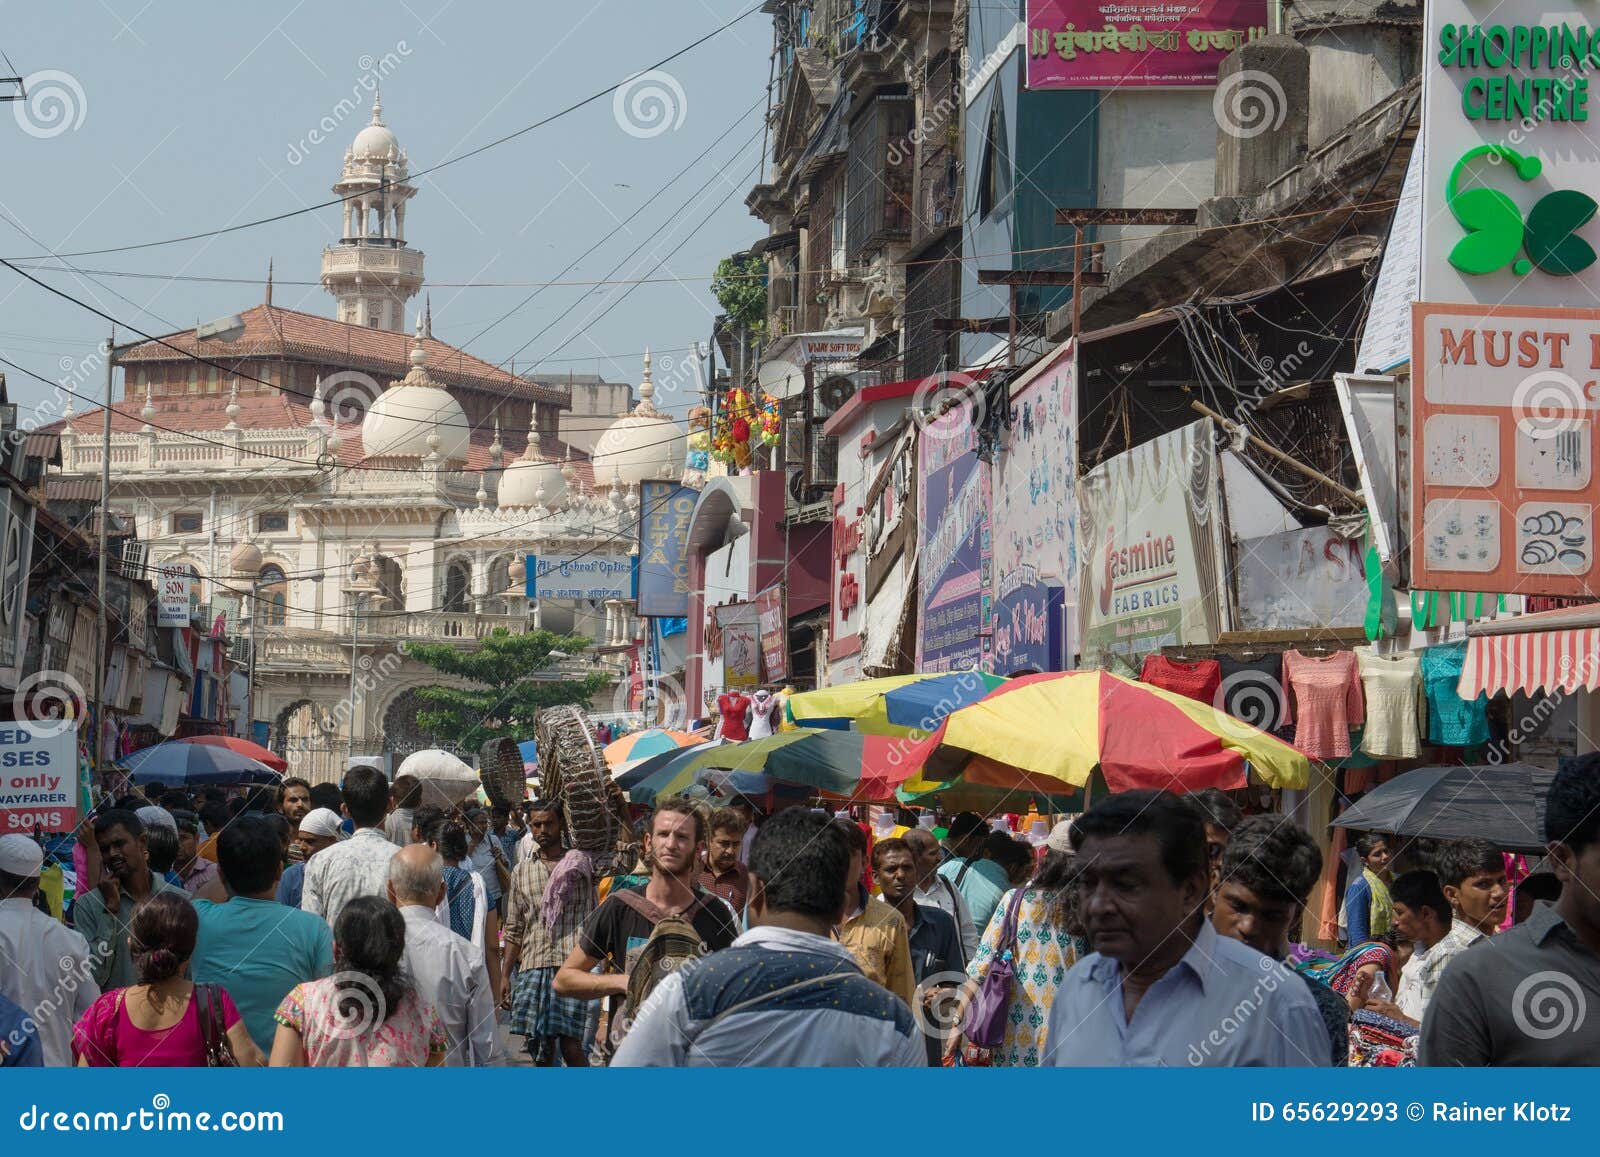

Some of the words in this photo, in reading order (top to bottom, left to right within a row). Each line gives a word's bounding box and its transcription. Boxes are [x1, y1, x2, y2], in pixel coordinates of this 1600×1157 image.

[1462, 73, 1588, 121] CENTRE
[829, 342, 845, 353] SOFT
[846, 342, 860, 353] TOYS
[1440, 328, 1569, 369] MUST
[648, 483, 670, 564] DELTA
[1100, 525, 1176, 617] Jasmine
[166, 582, 184, 594] SON
[1114, 584, 1179, 615] FABRICS
[0, 751, 50, 767] SES
[10, 773, 60, 791] only
[8, 811, 62, 828] SONS
